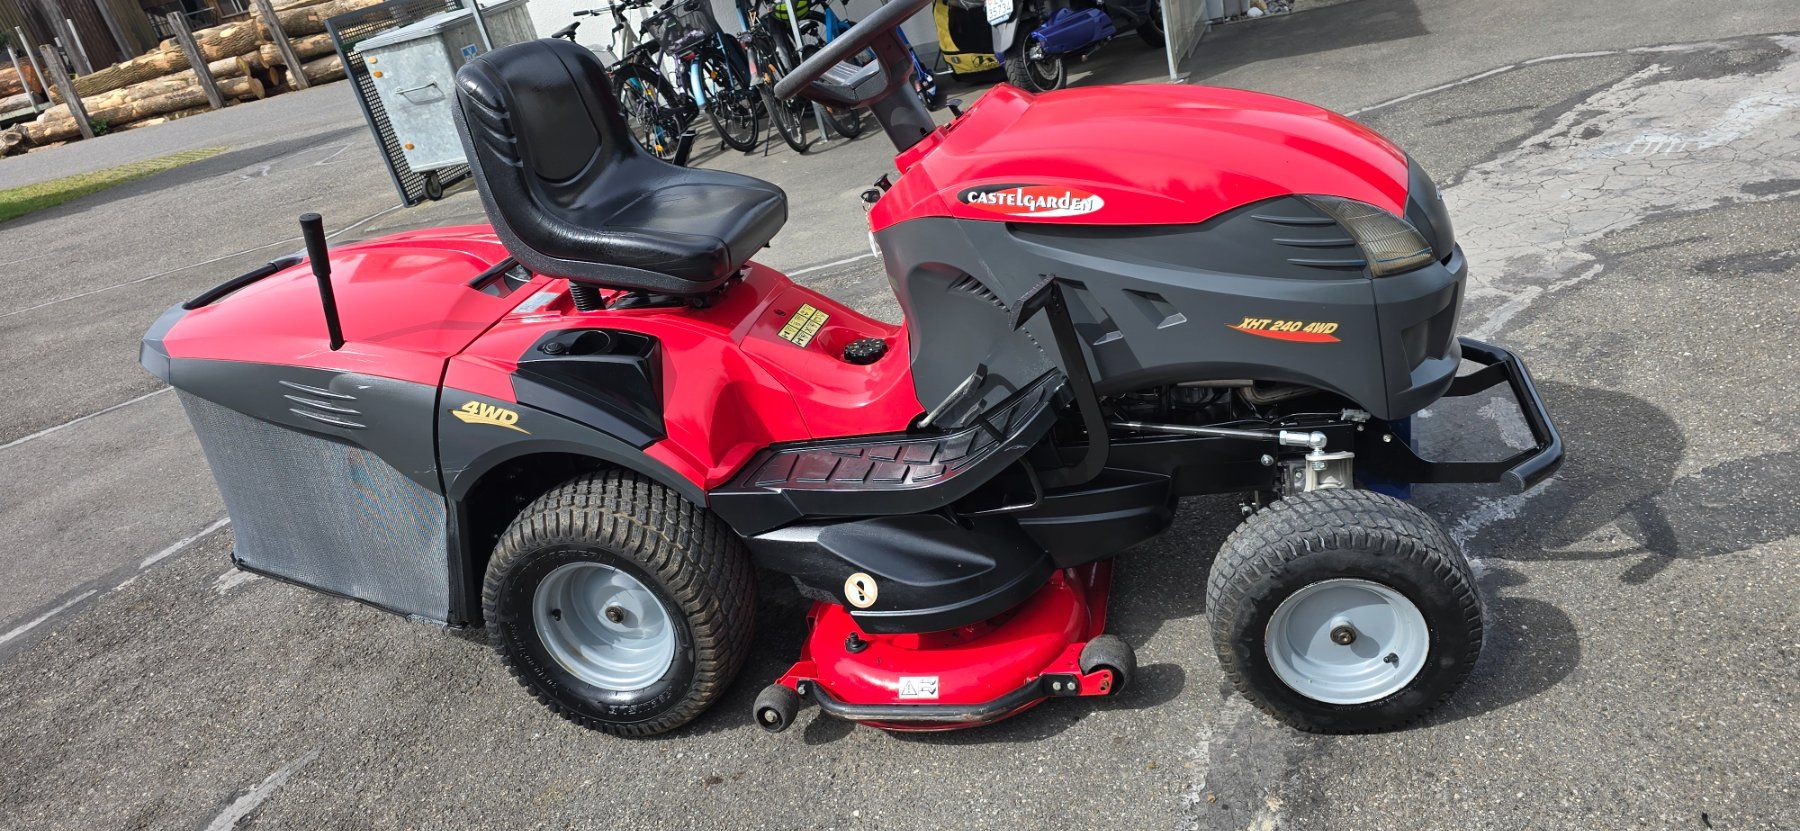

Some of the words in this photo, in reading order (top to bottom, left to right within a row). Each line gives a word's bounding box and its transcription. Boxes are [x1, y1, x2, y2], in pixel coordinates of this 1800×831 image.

[1239, 317, 1272, 330] XHT
[1269, 320, 1303, 332] 240
[1303, 322, 1339, 334] 4WD
[461, 400, 519, 425] 4WD
